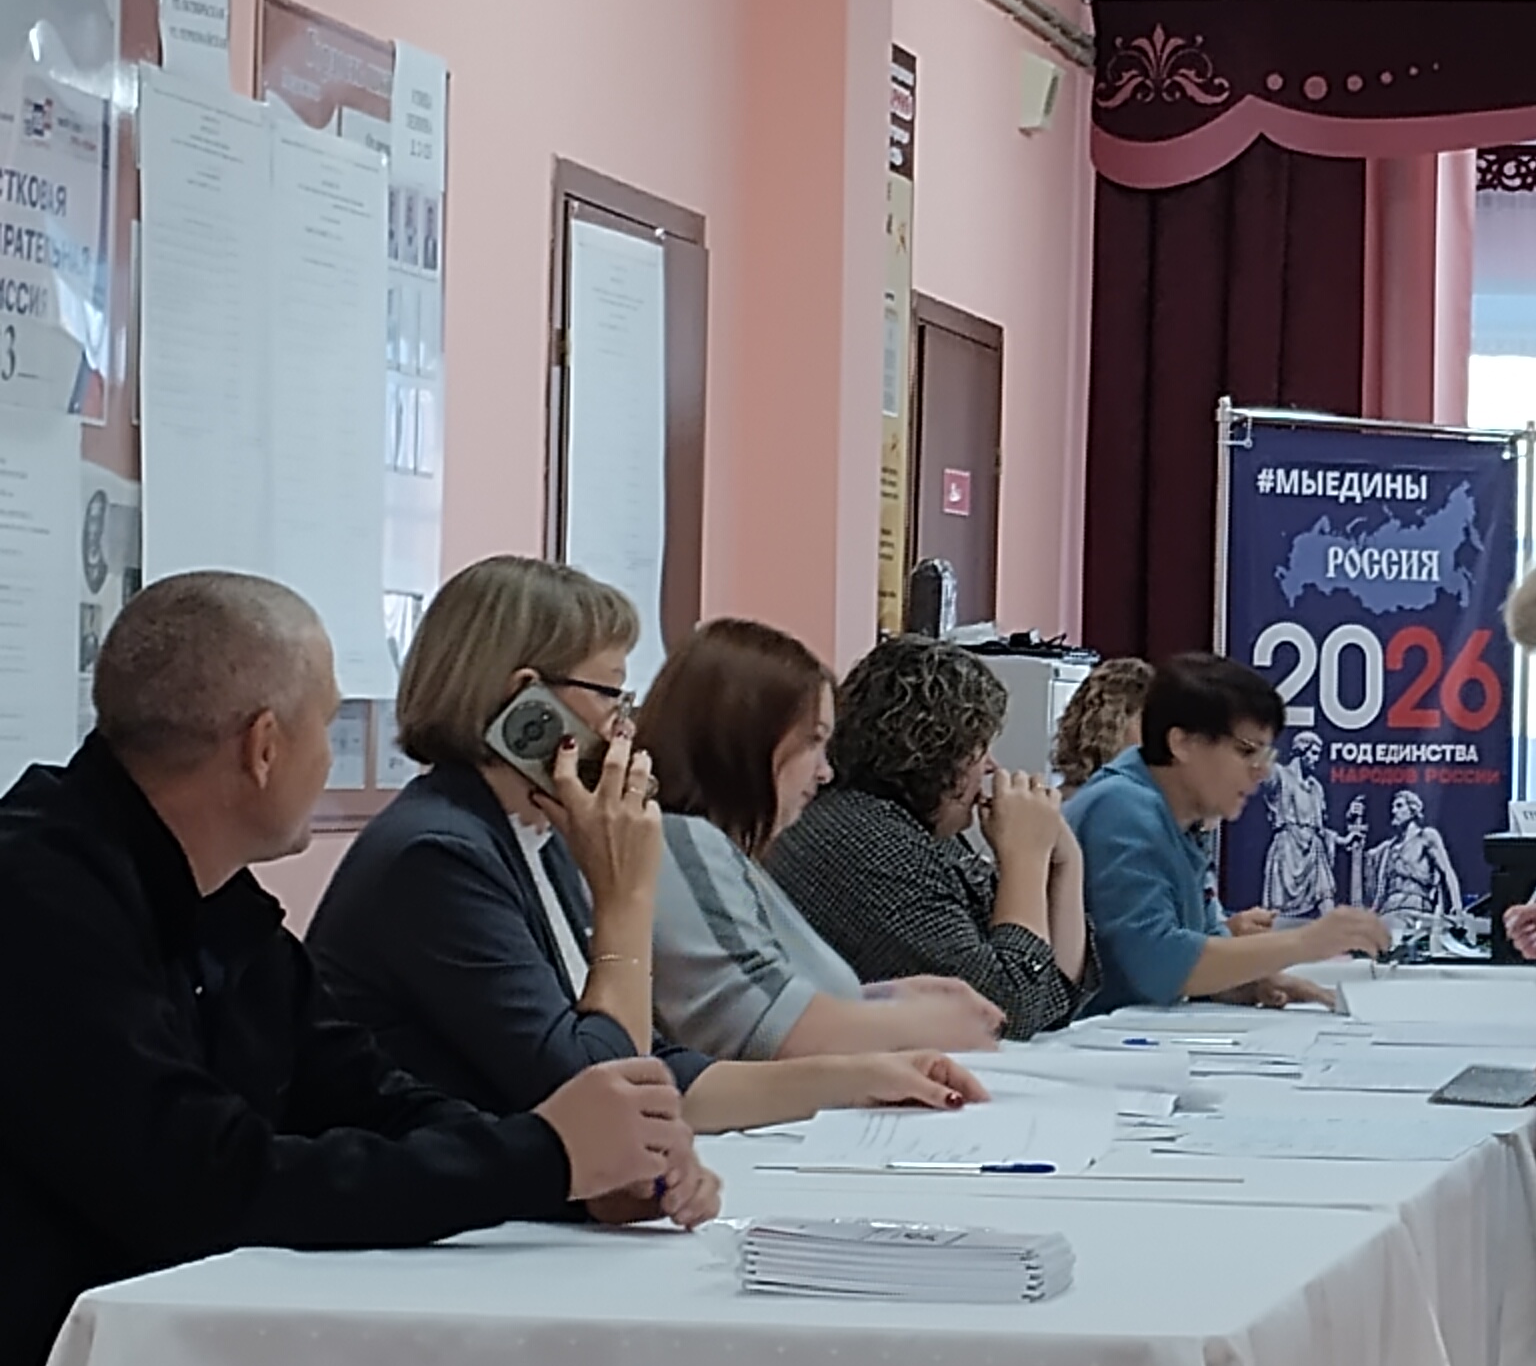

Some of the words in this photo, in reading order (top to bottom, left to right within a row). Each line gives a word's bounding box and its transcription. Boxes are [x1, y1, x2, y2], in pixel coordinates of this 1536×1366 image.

[1256, 468, 1428, 504] #МЫЕДИНЫ
[1326, 546, 1440, 582] РОССИЯ
[1253, 621, 1502, 732] 2026
[1329, 742, 1373, 764] ГОД
[1375, 743, 1480, 765] ЕДИНСТВА
[1330, 765, 1419, 785] НАРОДОВ
[1424, 767, 1502, 785] РОССИИ
